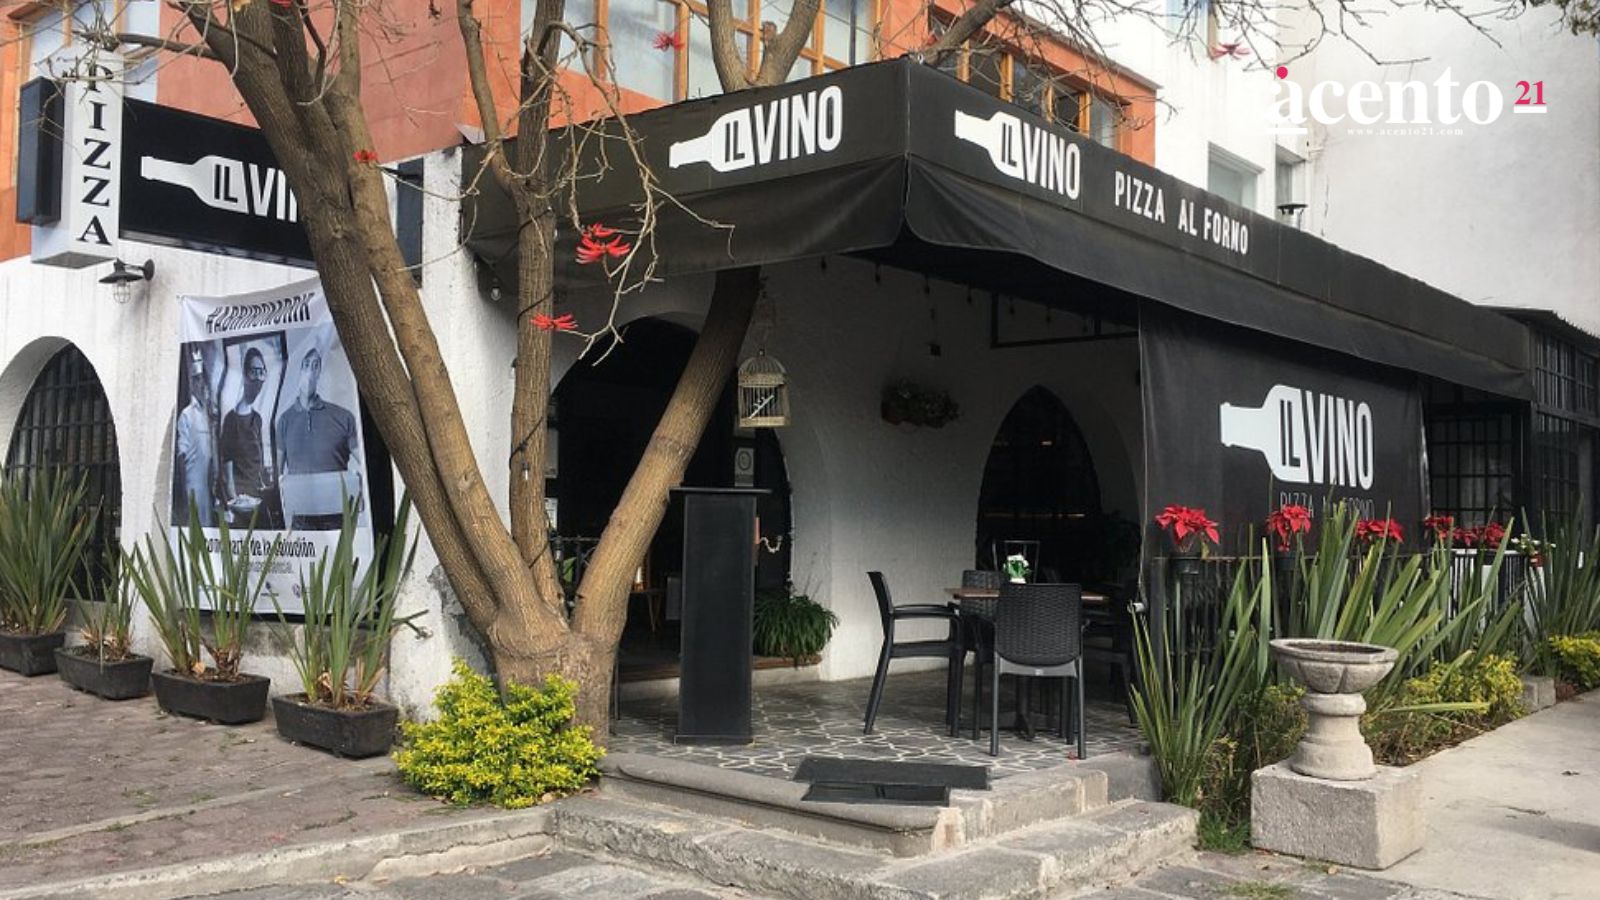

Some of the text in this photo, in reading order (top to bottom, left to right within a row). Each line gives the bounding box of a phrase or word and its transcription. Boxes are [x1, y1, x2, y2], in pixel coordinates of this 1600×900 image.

[76, 60, 115, 246] PIZZA
[754, 85, 843, 165] VINO
[1023, 121, 1080, 200] VINO
[1115, 170, 1248, 255] PIZZA AL FORNO
[1305, 389, 1373, 490] VINO
